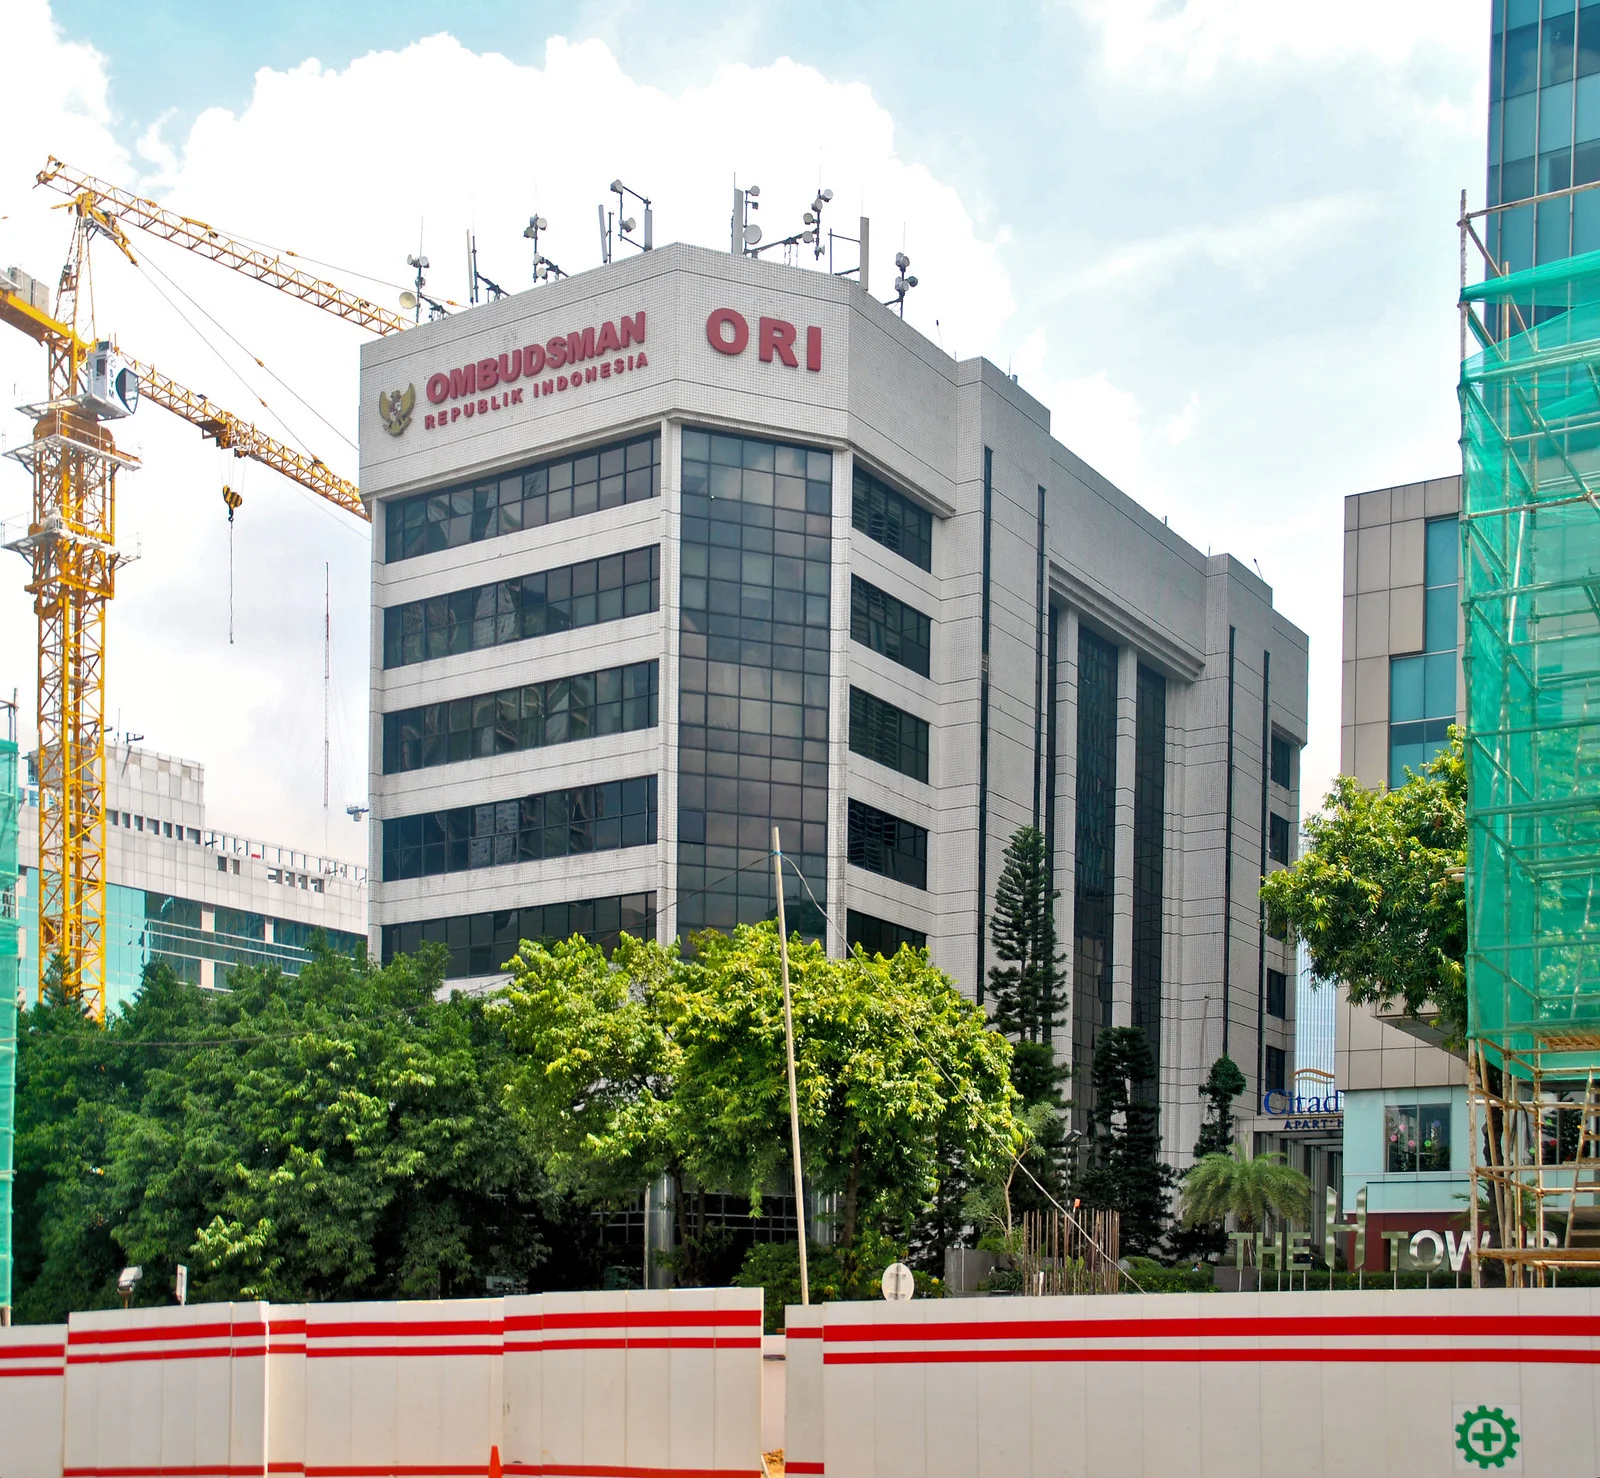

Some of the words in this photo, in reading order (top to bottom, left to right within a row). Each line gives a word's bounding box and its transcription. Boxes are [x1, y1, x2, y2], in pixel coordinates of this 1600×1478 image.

[426, 311, 646, 404] OMBUDSMAN
[706, 307, 822, 372] ORI
[424, 387, 524, 430] REPUBLIK
[533, 352, 648, 398] INDONESIA
[1228, 1231, 1312, 1271] THE
